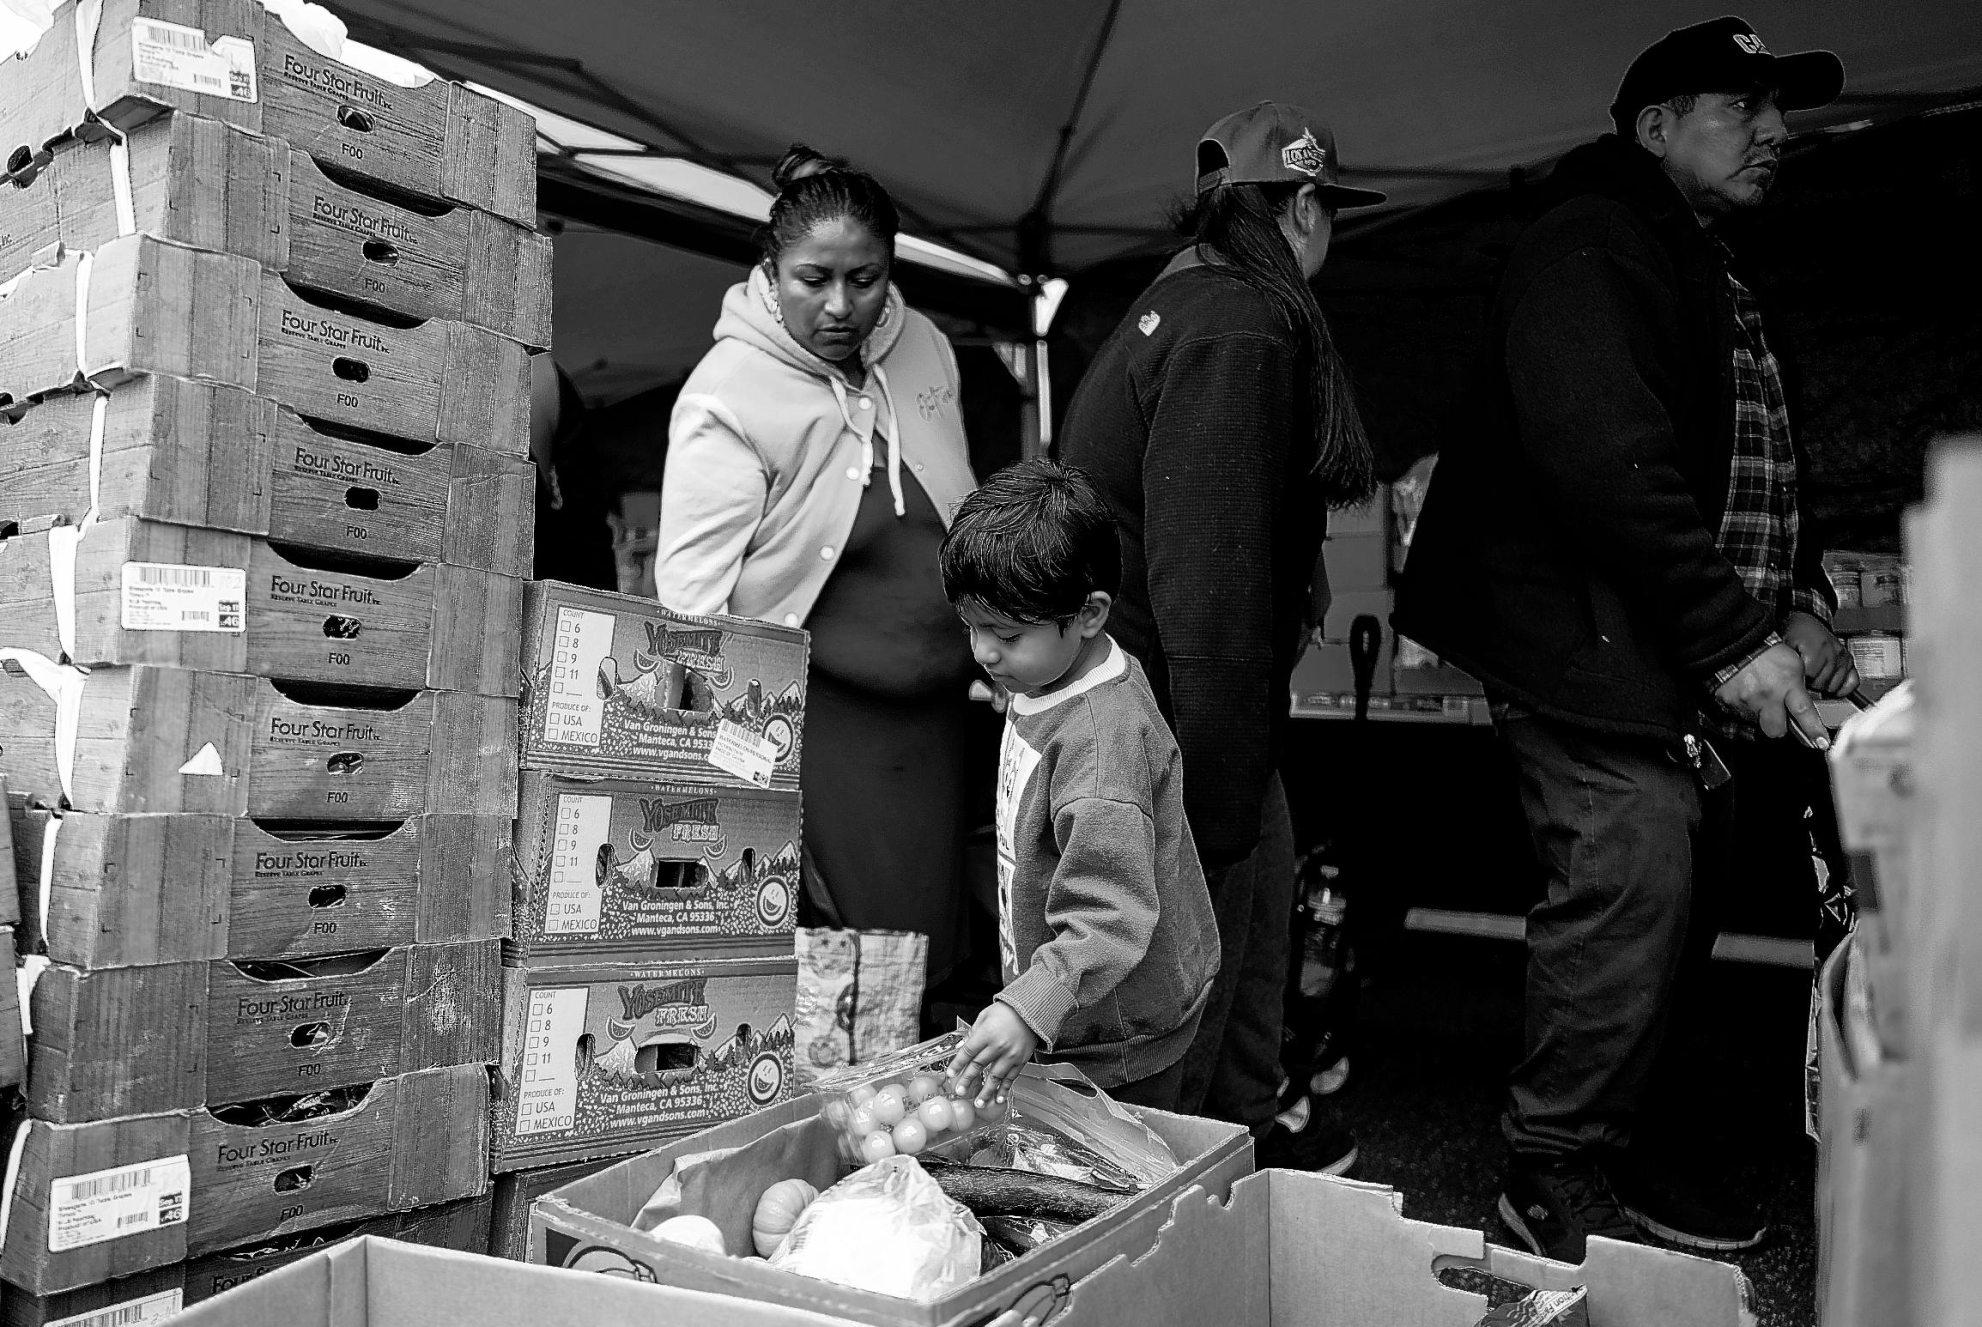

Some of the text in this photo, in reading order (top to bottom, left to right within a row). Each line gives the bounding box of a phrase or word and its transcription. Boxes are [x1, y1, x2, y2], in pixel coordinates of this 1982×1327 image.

[285, 54, 320, 81] Four
[322, 69, 351, 93] Star
[354, 81, 384, 106] Fruit
[314, 195, 348, 221] Four
[350, 208, 379, 230] Star
[381, 217, 410, 242] Fruit
[282, 309, 317, 333] Four
[320, 321, 349, 341] Star
[351, 328, 381, 351] Fruit
[295, 447, 329, 470] Four
[332, 456, 361, 476] Star
[363, 462, 393, 484] Fruit
[271, 575, 307, 596] Four
[309, 581, 340, 599] Star
[342, 585, 373, 604] Fruit
[563, 609, 584, 620] COUNT
[574, 623, 581, 634] 6
[572, 638, 579, 648] 8
[570, 653, 577, 664] 9
[570, 669, 579, 680] 11
[551, 701, 580, 712] PRODUCE
[563, 714, 582, 726] USA
[271, 717, 309, 736] Four
[312, 721, 343, 738] Star
[346, 724, 373, 740] Fruit
[623, 719, 641, 731] Van
[643, 722, 688, 737] Groningen
[689, 726, 696, 736] &
[561, 730, 598, 743] MEXICO
[679, 737, 691, 748] CA
[692, 738, 713, 750] 9533
[632, 747, 709, 761] www.vgandsons.c
[654, 785, 714, 795] WATERMELONS
[574, 808, 579, 819] 6
[572, 825, 578, 835] 8
[672, 823, 720, 842] FRESH
[571, 840, 577, 851] 9
[256, 852, 293, 870] Four
[296, 852, 326, 869] Star
[328, 851, 360, 868] Fruit
[570, 856, 578, 867] 11
[552, 891, 579, 899] PRODUCE
[564, 904, 582, 915] USA
[622, 901, 639, 911] Van
[640, 900, 684, 912] Groningen
[685, 900, 692, 910] &
[676, 912, 688, 923] CA
[689, 912, 715, 922] 95336
[561, 919, 597, 930] MEXICO
[633, 968, 701, 978] WATERMELONS
[535, 991, 556, 999] COUNT
[237, 998, 278, 1017] Four
[280, 996, 312, 1012] Star
[313, 991, 347, 1009] Fruit
[546, 1003, 553, 1015] 6
[655, 1004, 709, 1027] FRESH
[544, 1020, 551, 1031] 8
[543, 1036, 549, 1047] 9
[542, 1053, 551, 1064] 11
[523, 1089, 553, 1099] PRODUCE
[601, 1092, 618, 1104] Van
[621, 1087, 668, 1104] Groningen
[670, 1086, 677, 1096] &
[536, 1102, 555, 1114] USA
[659, 1099, 672, 1109] CA
[533, 1116, 572, 1130] MEXICO
[218, 1144, 256, 1164] Four
[259, 1138, 294, 1157] Star
[296, 1131, 329, 1150] Fruit
